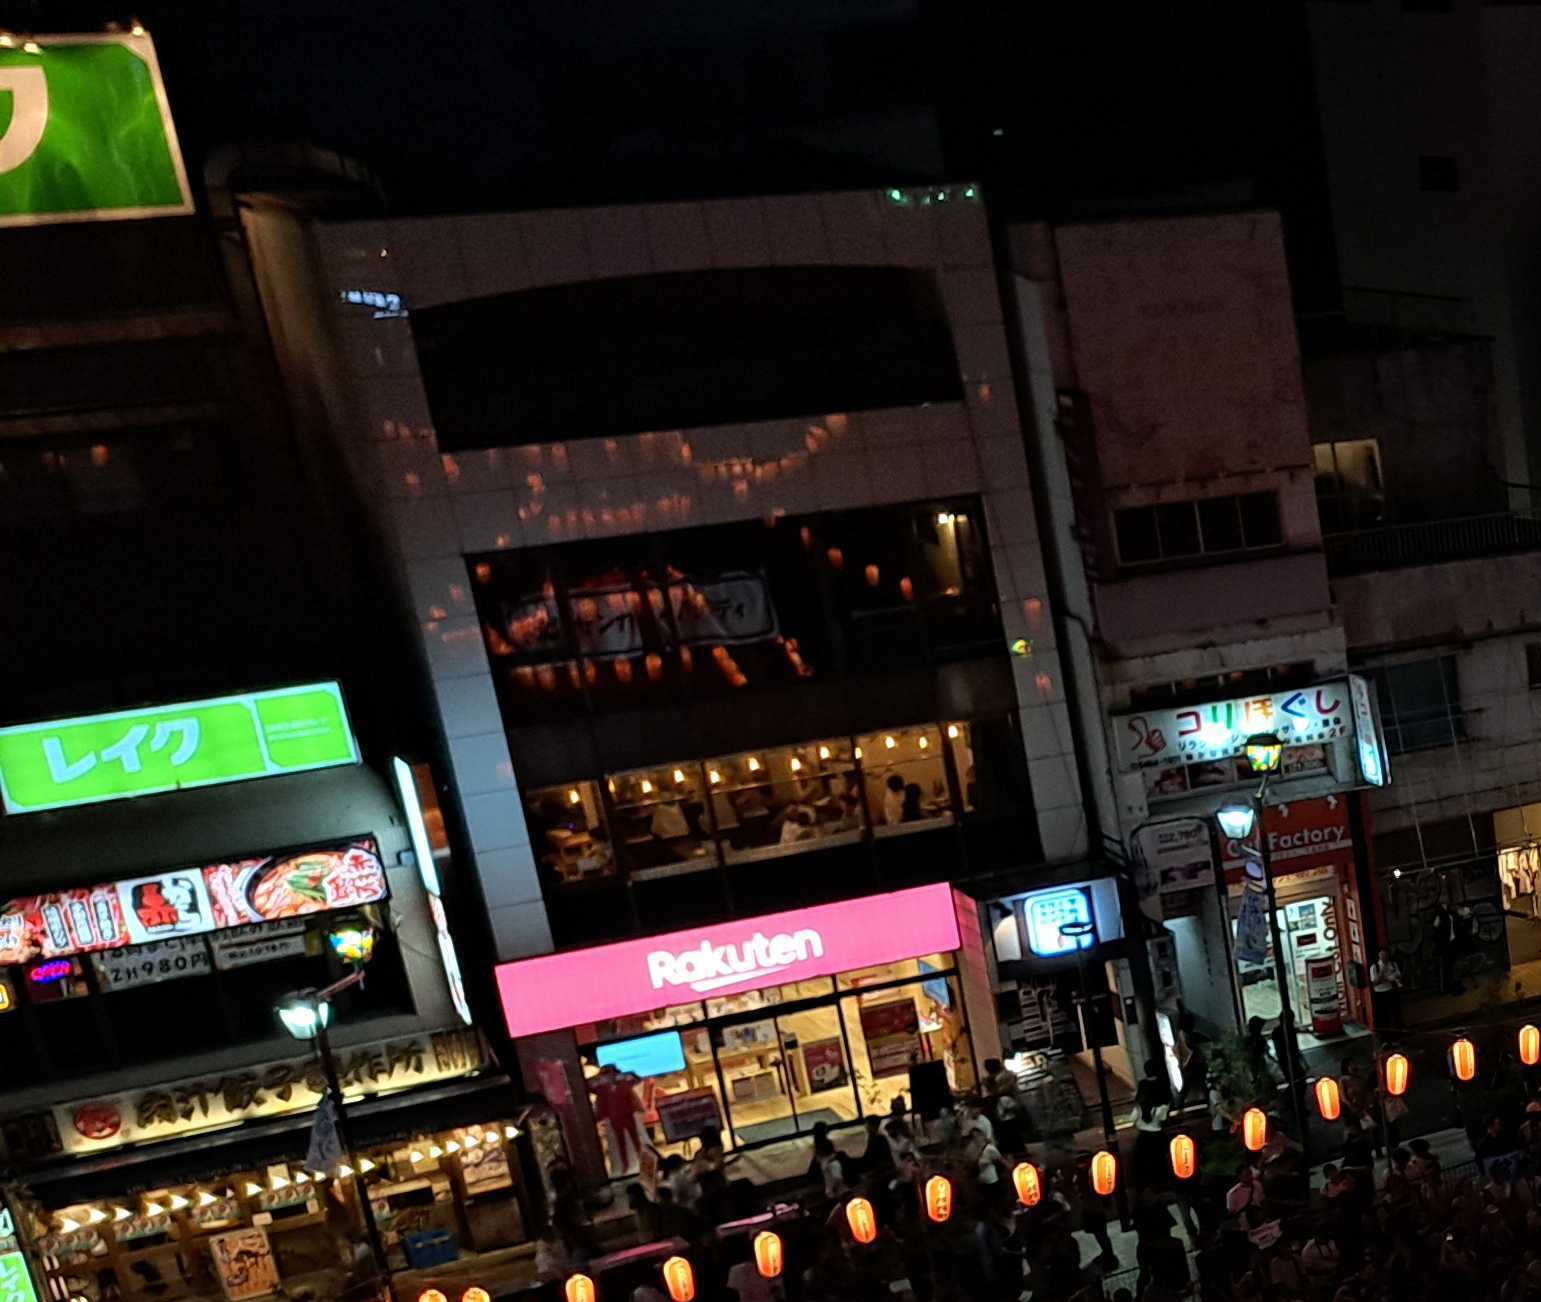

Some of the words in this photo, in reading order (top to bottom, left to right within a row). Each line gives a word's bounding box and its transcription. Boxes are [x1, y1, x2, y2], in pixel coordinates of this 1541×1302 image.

[1176, 688, 1341, 737] コリほぐし
[43, 716, 201, 784] レイク
[1267, 825, 1345, 850] Factory
[646, 927, 824, 991] Rakuten
